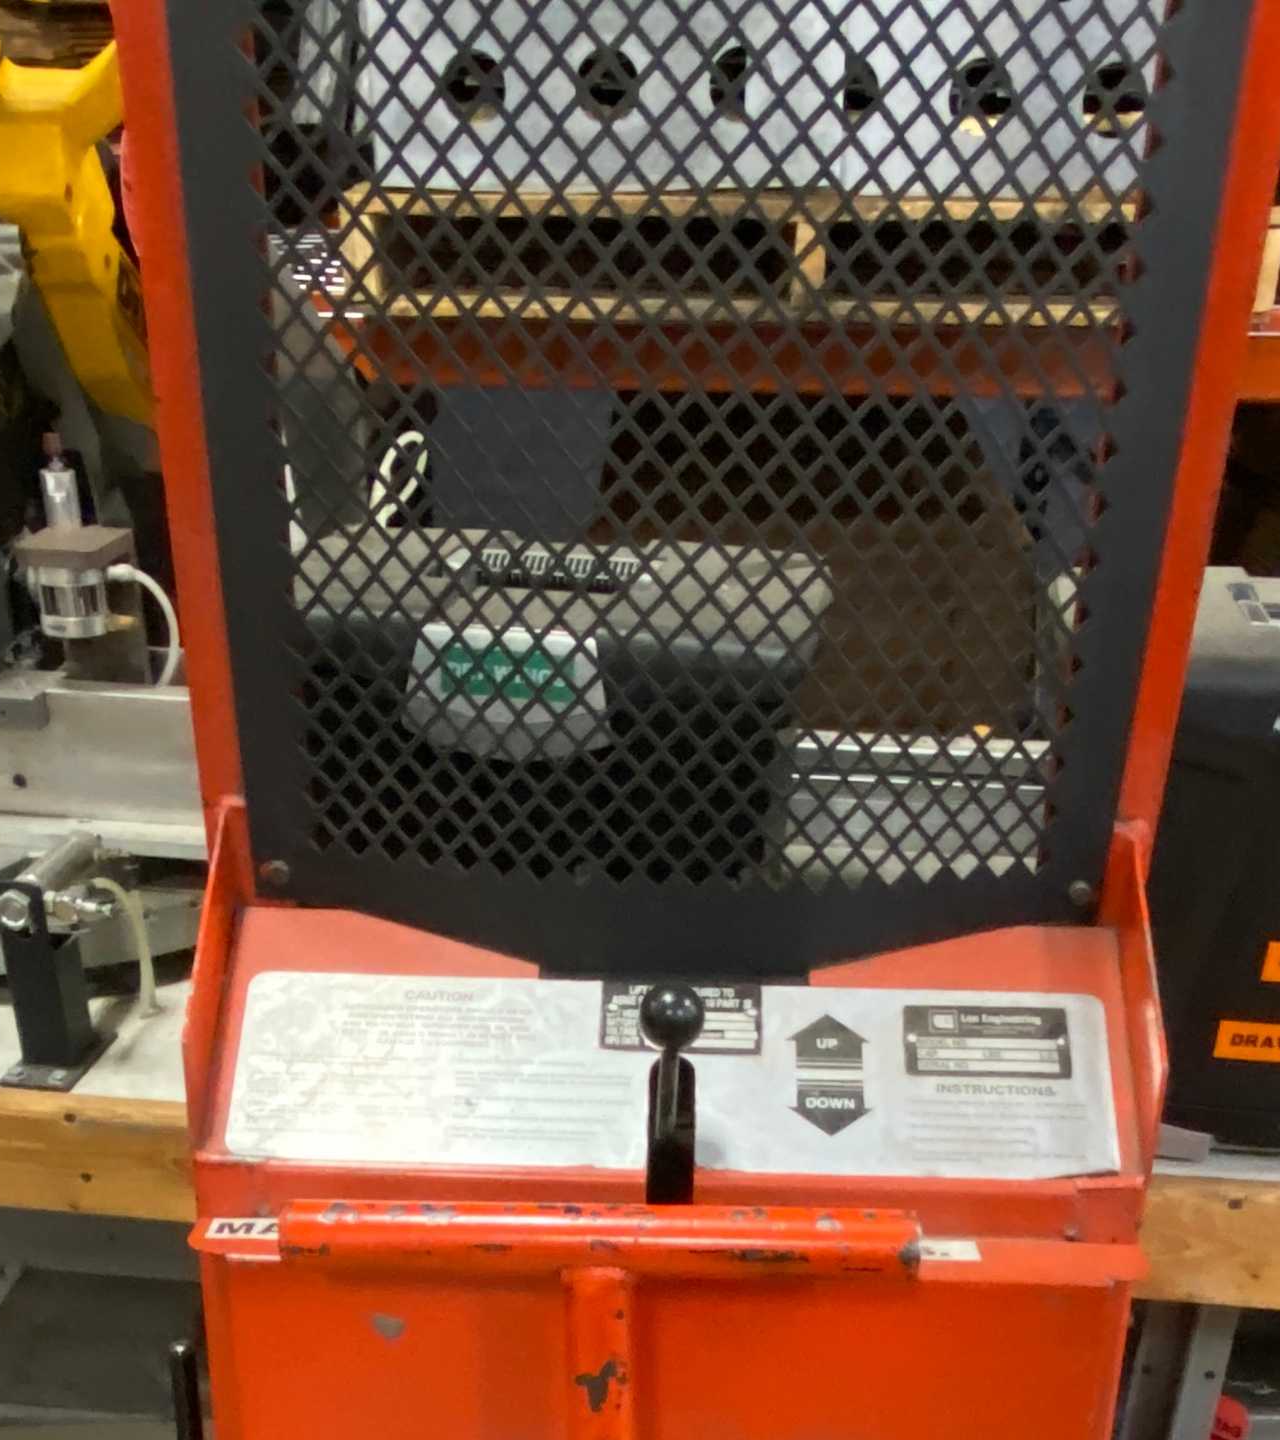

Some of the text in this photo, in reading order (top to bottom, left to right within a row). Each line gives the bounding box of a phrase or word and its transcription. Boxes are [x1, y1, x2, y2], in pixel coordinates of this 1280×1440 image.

[404, 990, 474, 1002] CAUTION
[816, 1038, 839, 1049] UP
[805, 1097, 855, 1109] DOWN
